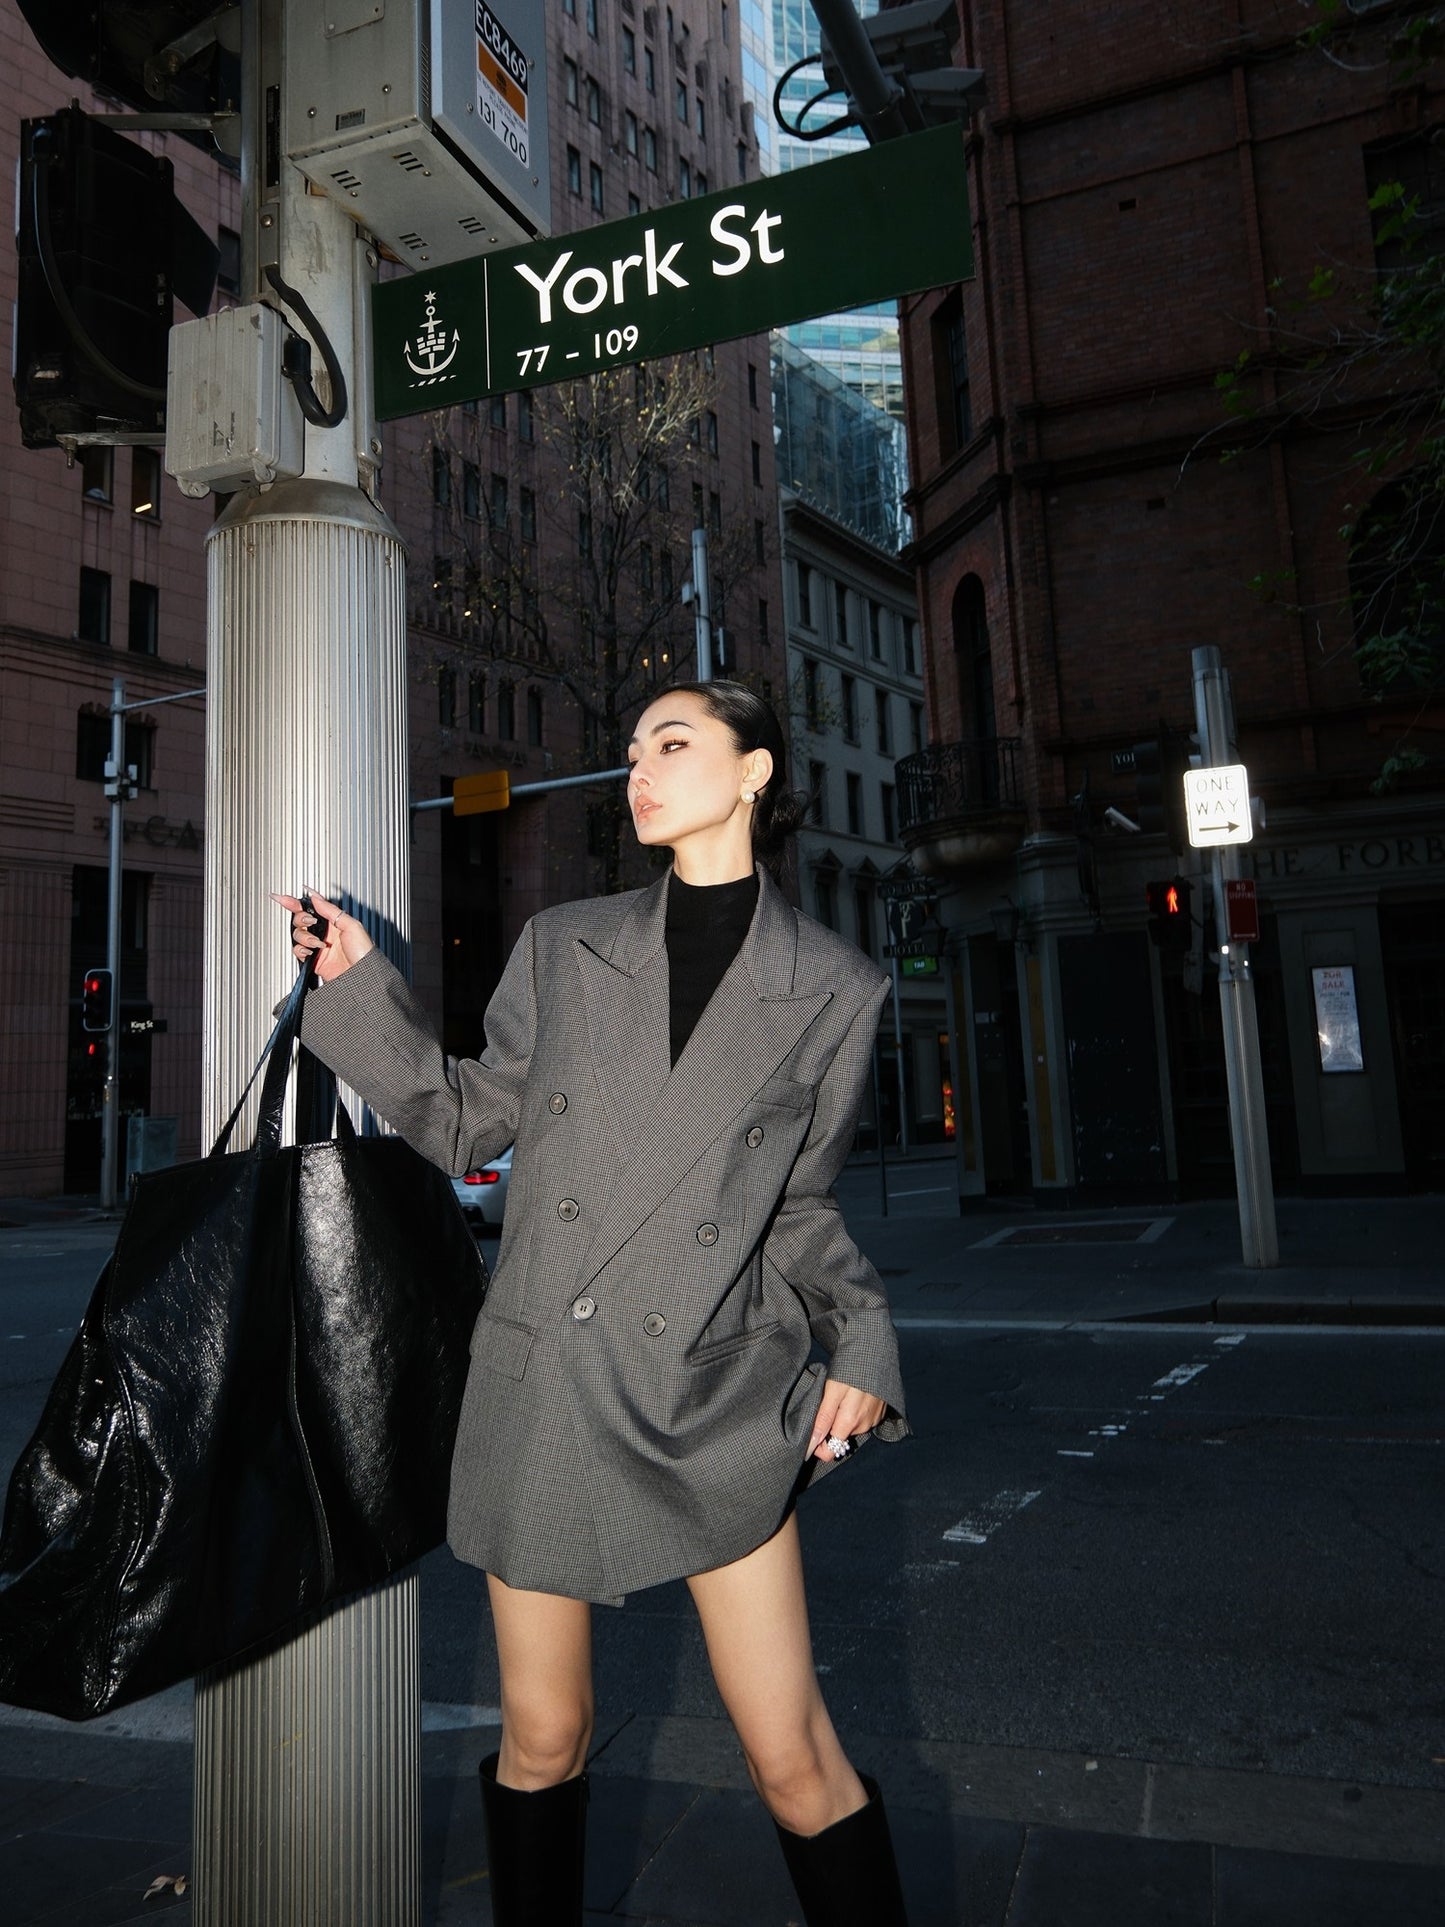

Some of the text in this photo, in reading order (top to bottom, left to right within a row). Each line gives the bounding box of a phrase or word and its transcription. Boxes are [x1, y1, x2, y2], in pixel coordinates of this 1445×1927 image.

[476, 3, 527, 84] EC8469
[479, 96, 496, 131] 131
[501, 121, 527, 163] 700
[514, 205, 784, 323] York St
[517, 345, 550, 376] 77
[595, 325, 638, 358] 109
[1195, 799, 1238, 816] WAY
[1196, 775, 1233, 793] ONE
